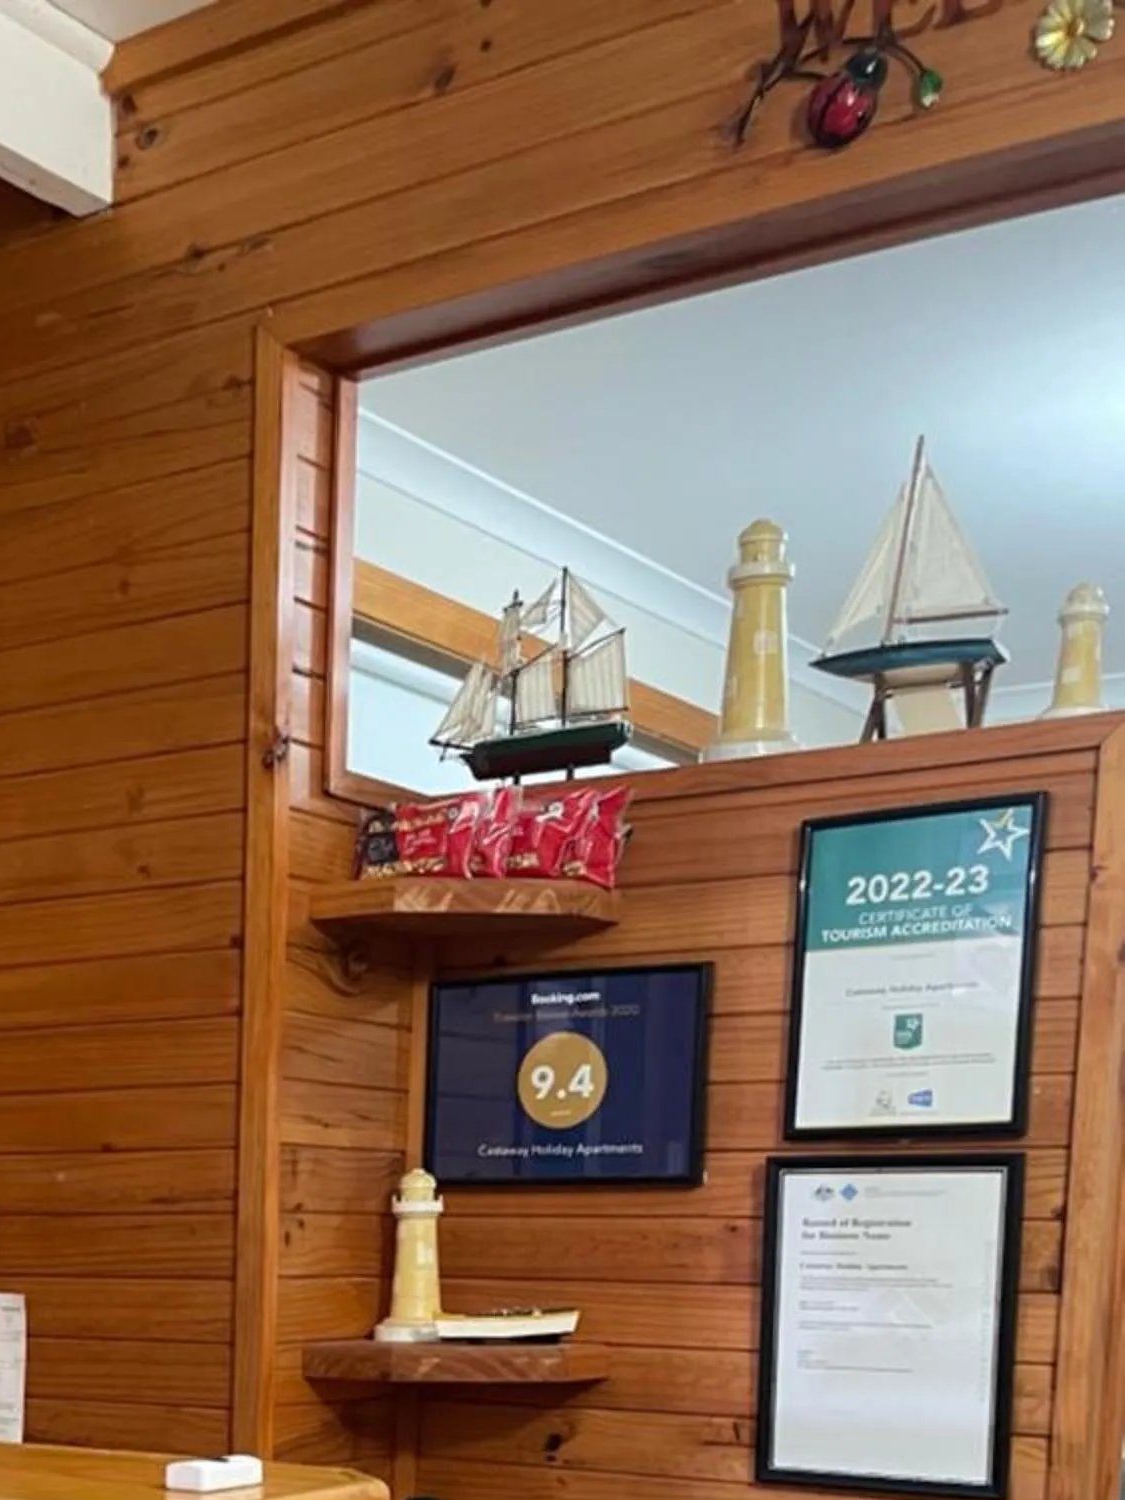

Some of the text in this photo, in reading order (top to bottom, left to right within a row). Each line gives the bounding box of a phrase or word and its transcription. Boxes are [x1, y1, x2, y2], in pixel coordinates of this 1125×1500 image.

[845, 864, 990, 906] 2022-23
[858, 903, 975, 925] CERTIFICATE OF
[821, 915, 1013, 943] TOURISM ACCREDITATION
[531, 991, 601, 1006] Booking.com
[530, 1063, 595, 1100] 9.4
[477, 1141, 643, 1159] Castaway Holiday Apartments
